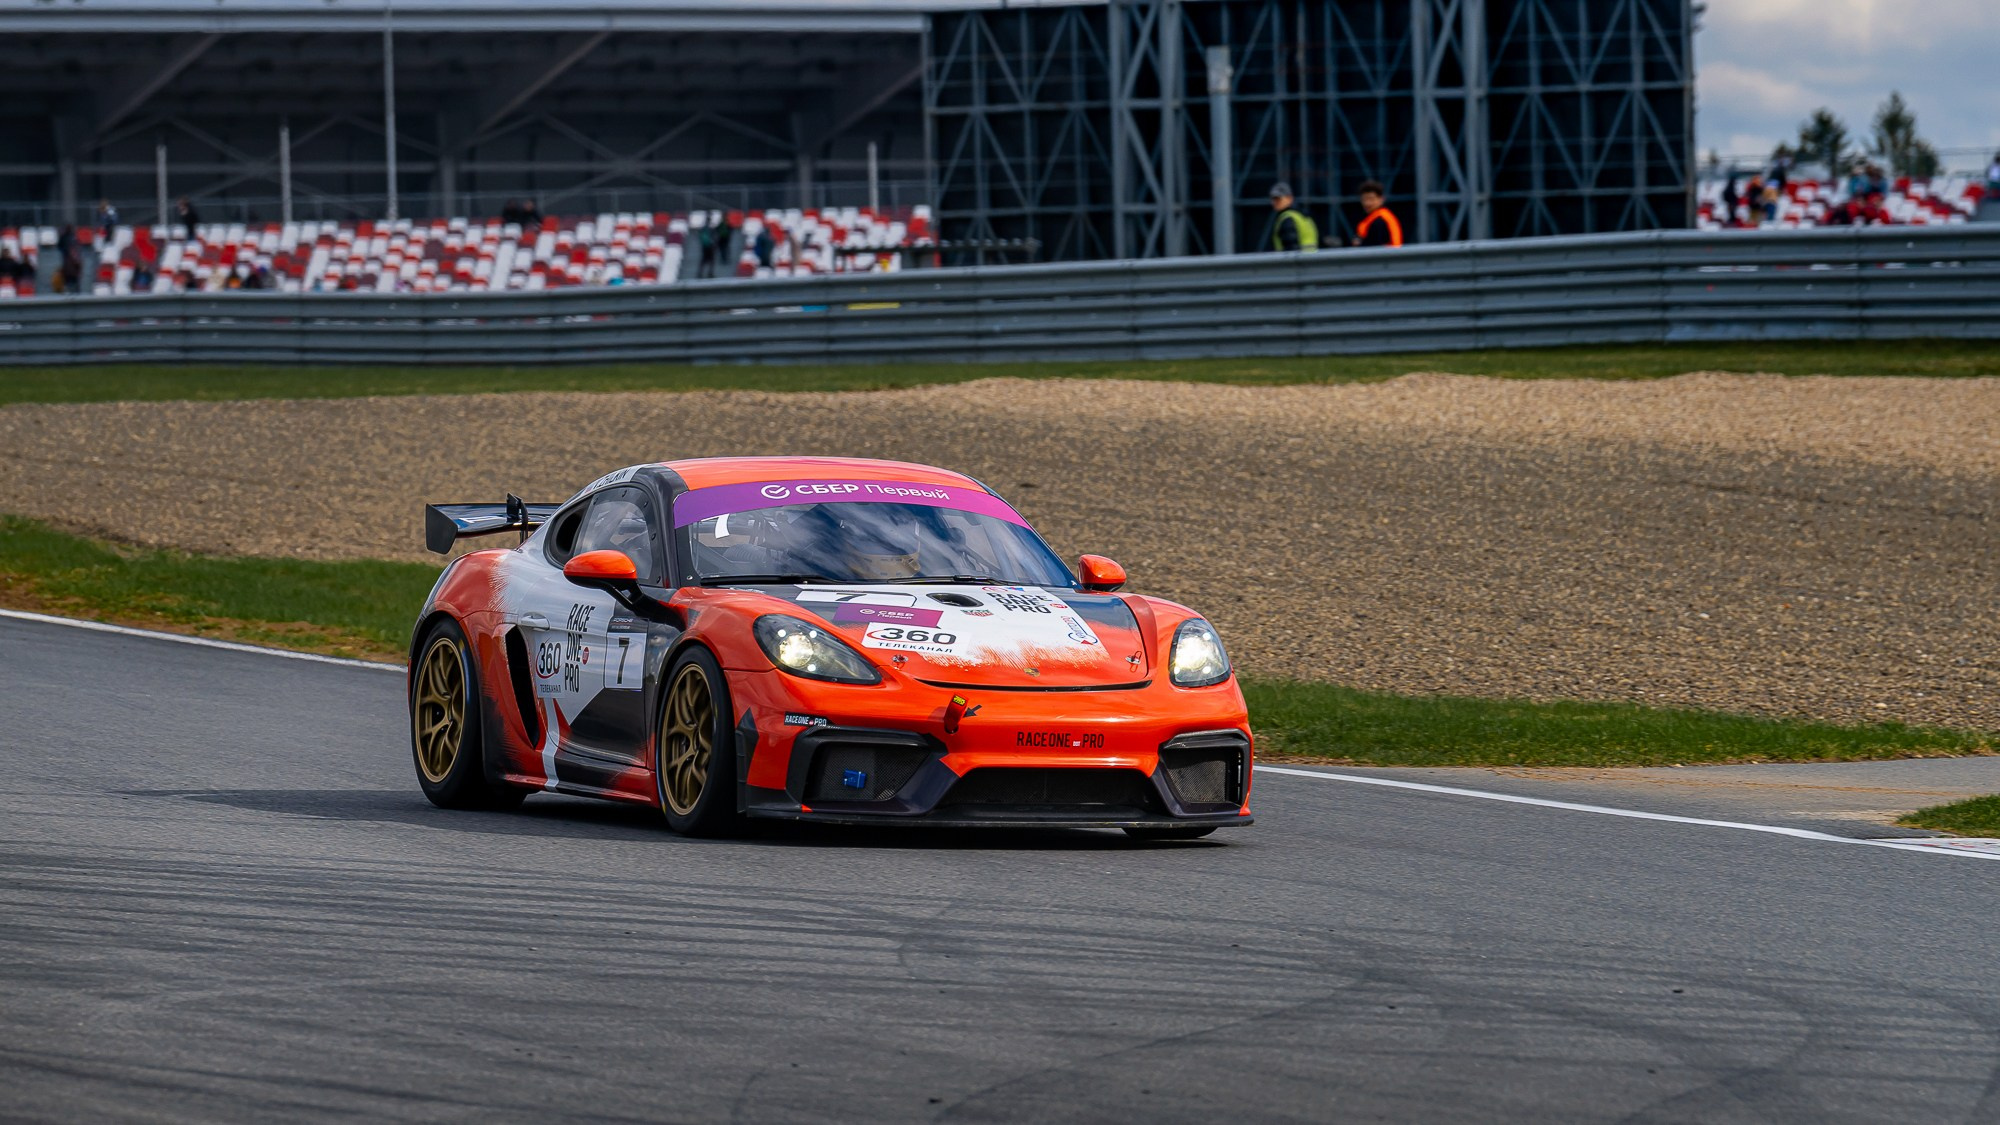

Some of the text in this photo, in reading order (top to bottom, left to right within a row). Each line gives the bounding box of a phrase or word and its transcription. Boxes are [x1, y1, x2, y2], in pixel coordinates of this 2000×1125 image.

[795, 484, 950, 500] СБЕР Первый
[835, 592, 867, 602] 7
[986, 592, 1052, 602] RACE
[996, 598, 1044, 606] ONE
[1003, 604, 1052, 613] PRO
[566, 603, 596, 632] RACE
[880, 627, 957, 645] 360
[566, 632, 582, 662] ONE
[878, 641, 953, 653] ТЕЛЕКАНАЛ
[539, 642, 561, 675] 360
[617, 637, 630, 684] 7
[564, 662, 580, 693] PRO
[540, 684, 561, 693] ТЕЛЕКАНАЛ
[1082, 733, 1105, 748] PRO
